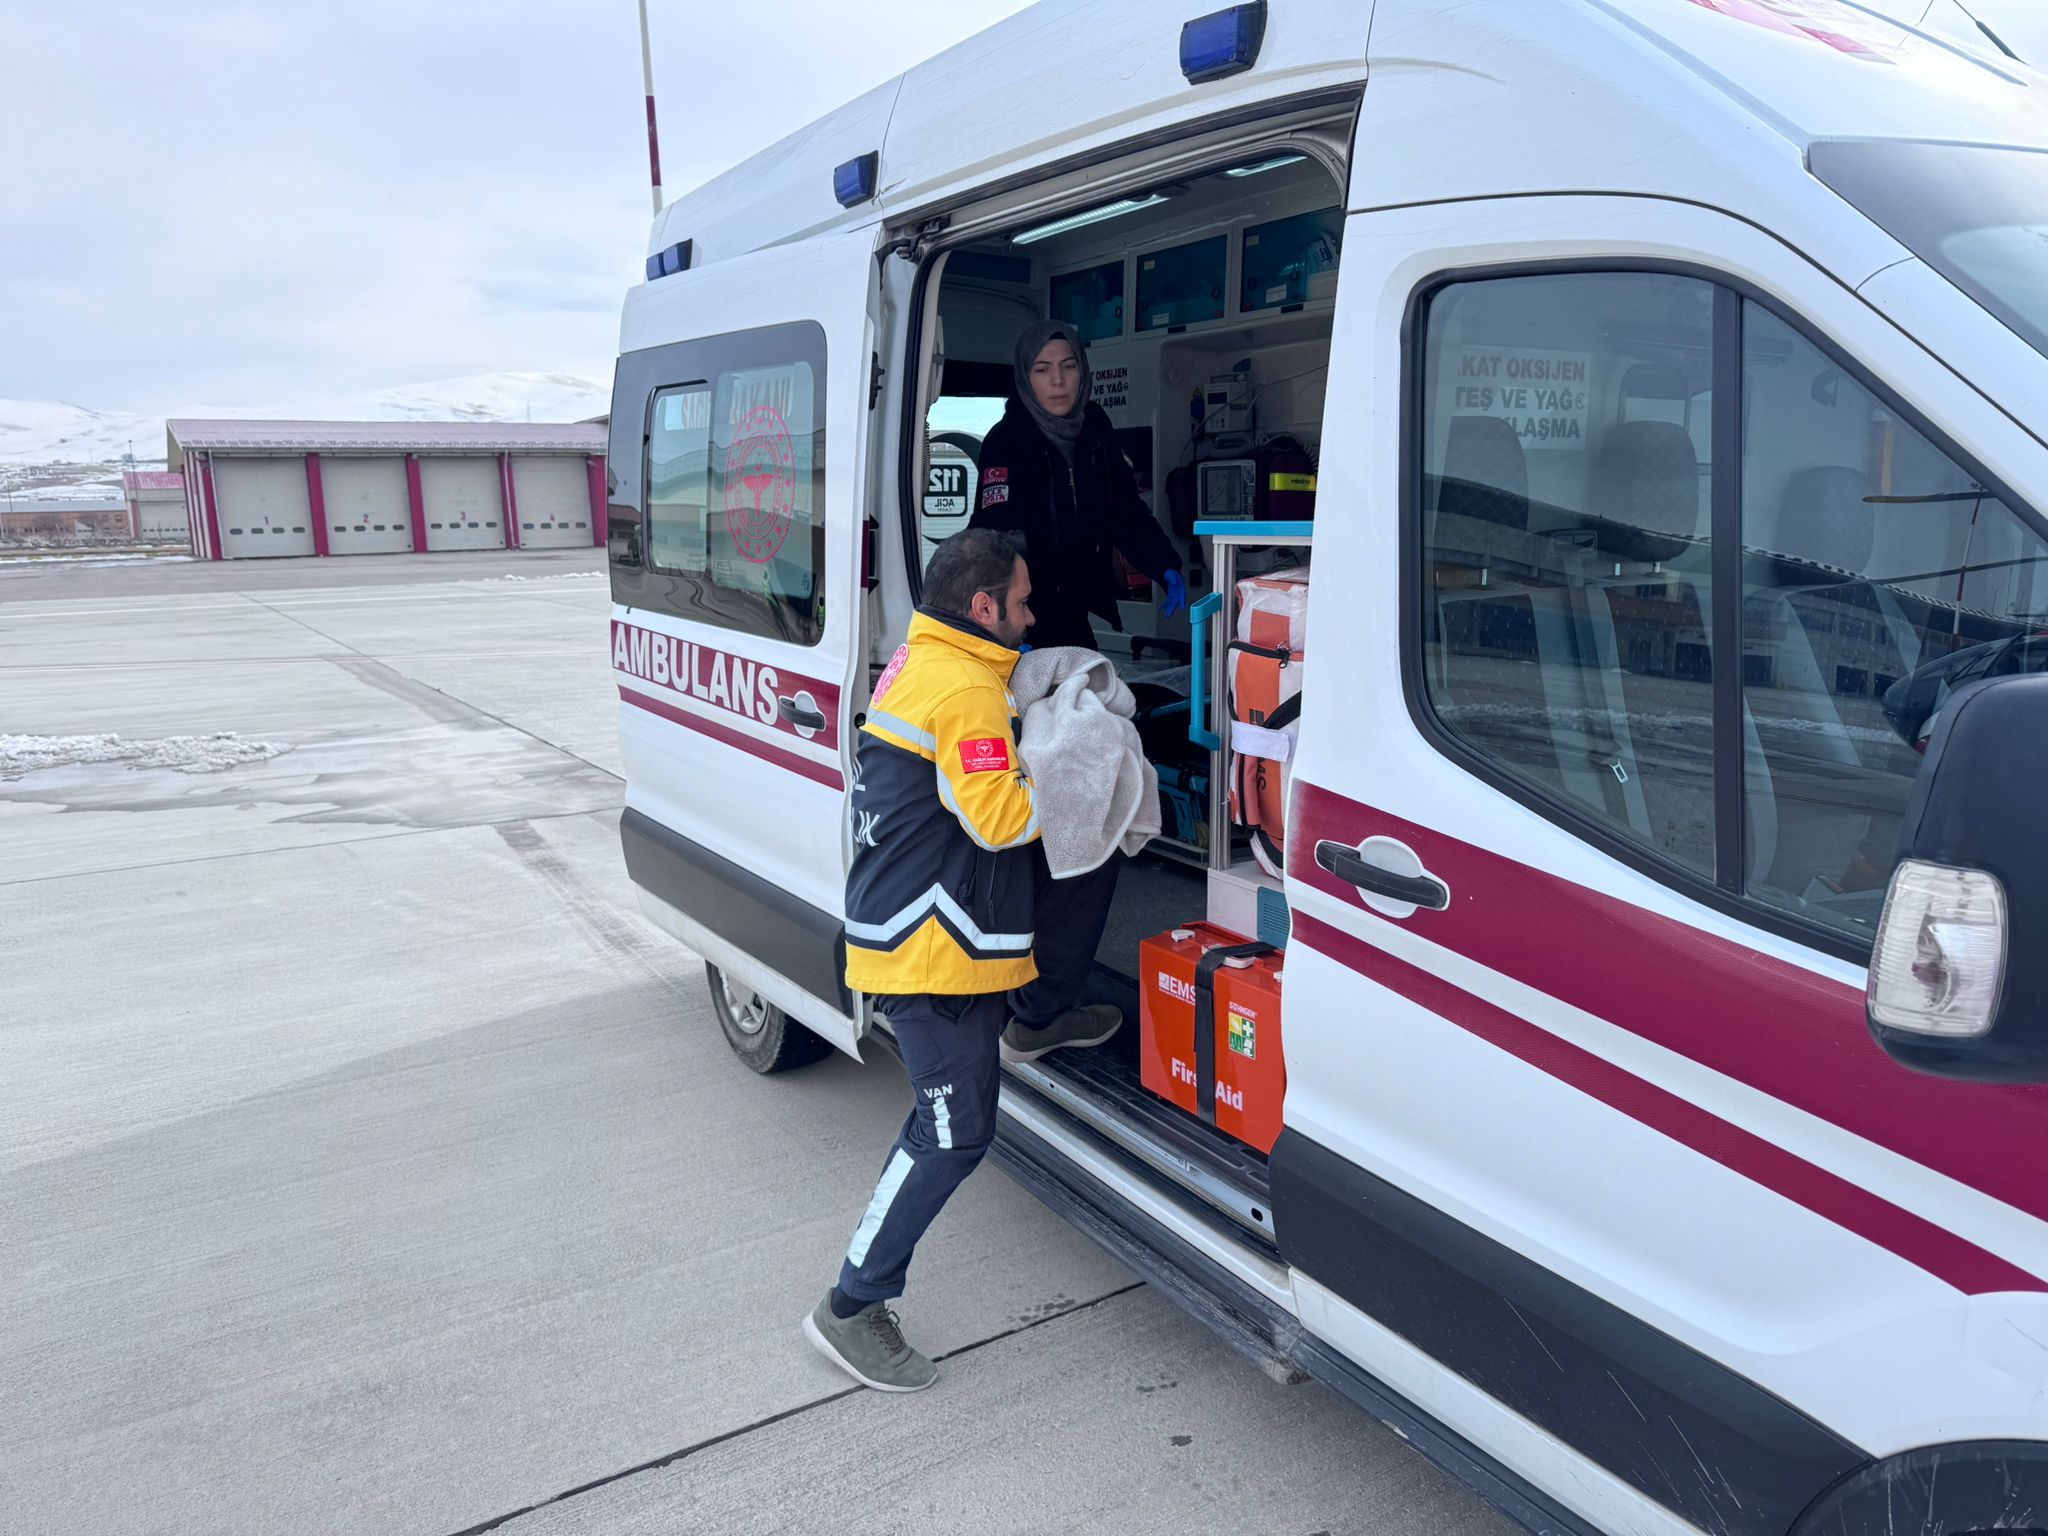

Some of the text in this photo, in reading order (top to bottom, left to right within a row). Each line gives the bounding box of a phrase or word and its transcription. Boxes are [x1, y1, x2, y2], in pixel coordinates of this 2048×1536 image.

[1458, 355, 1502, 378] KAT
[1094, 384, 1104, 395] VE
[1455, 386, 1494, 412] TEŞ
[1500, 388, 1528, 409] VE
[613, 622, 779, 726] AMBULANS
[923, 1083, 953, 1099] VAN
[1215, 1080, 1243, 1112] Aid
